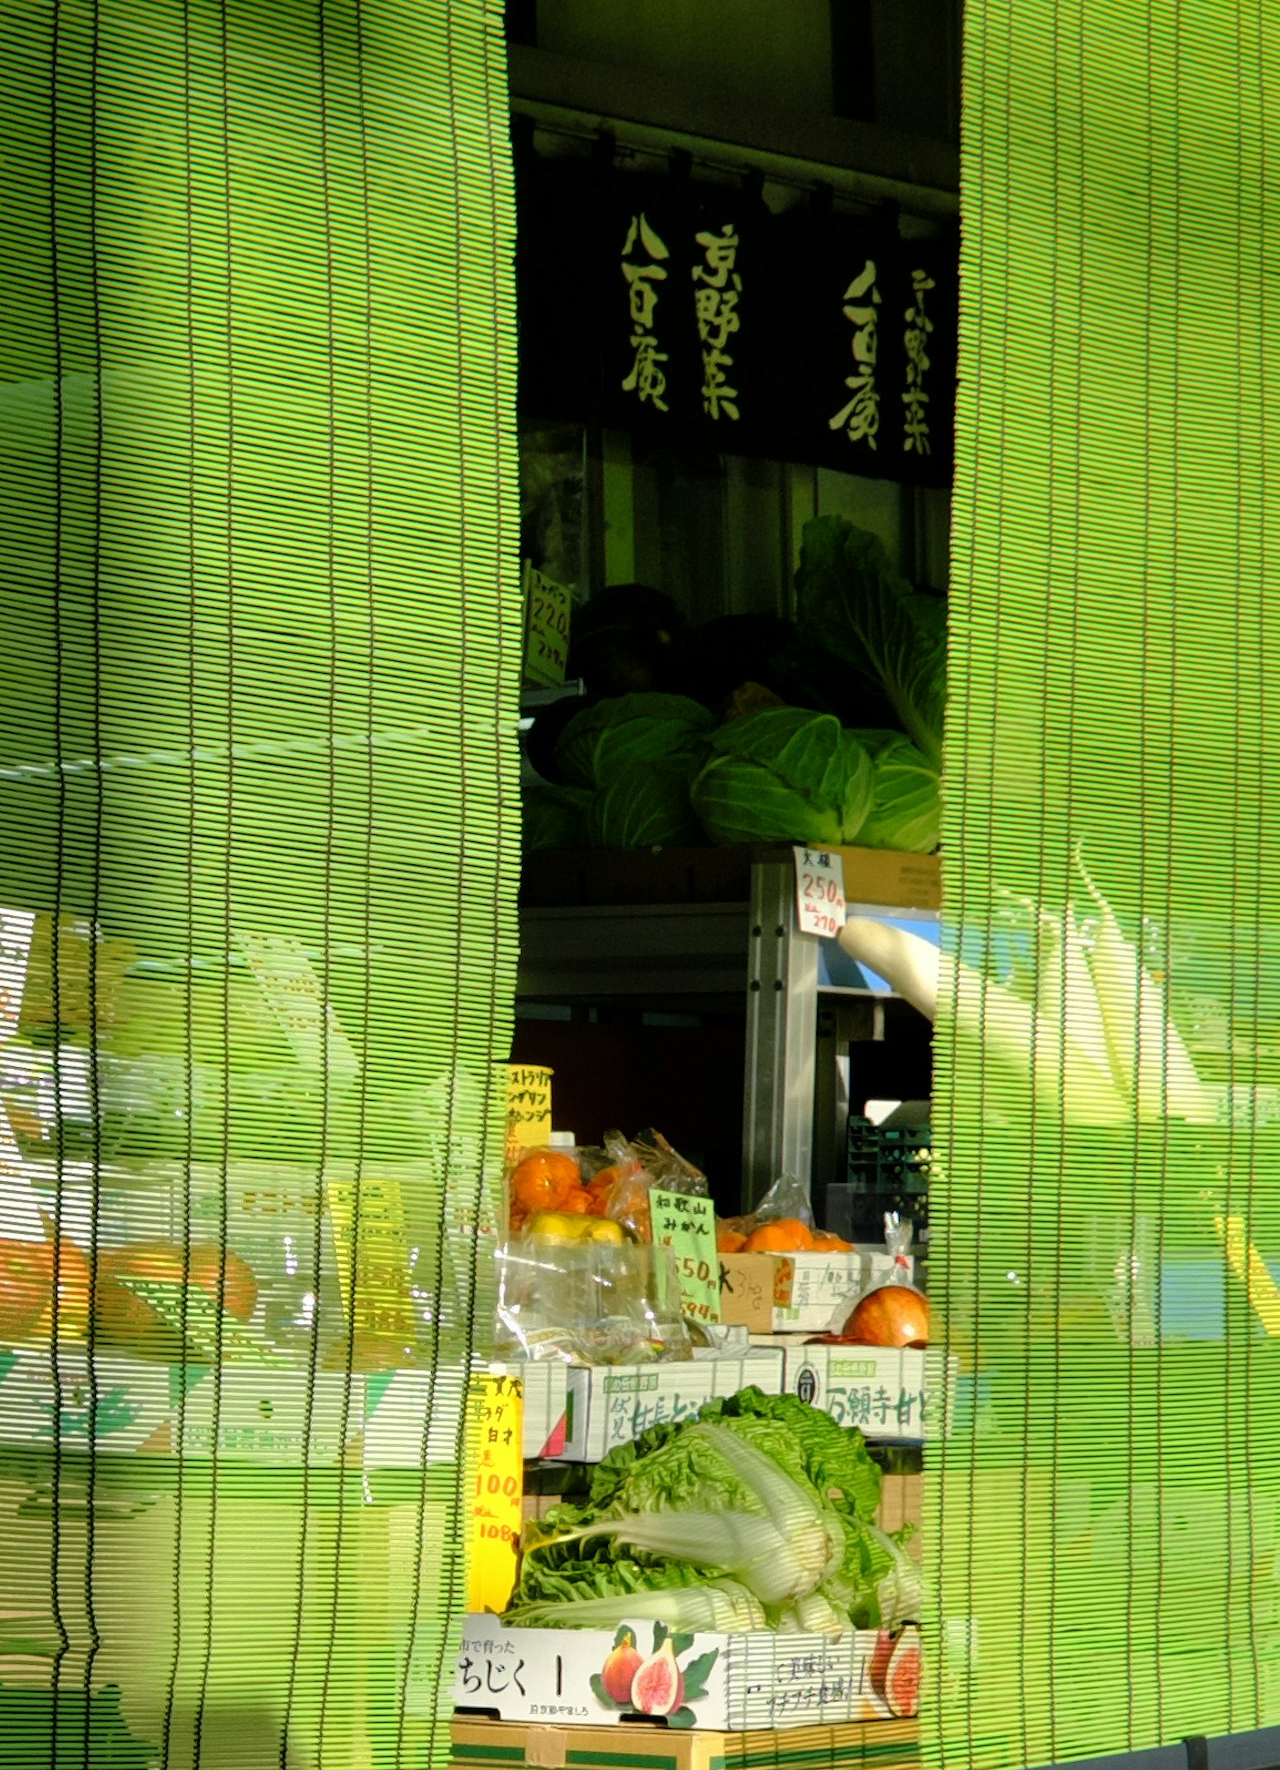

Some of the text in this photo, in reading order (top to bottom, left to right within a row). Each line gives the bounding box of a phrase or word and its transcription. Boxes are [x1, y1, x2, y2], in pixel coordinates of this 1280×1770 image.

[621, 212, 670, 413] 八百廣
[691, 222, 743, 422] 京野菜
[900, 268, 936, 456] 京野菜
[655, 1194, 707, 1215] 和歌山
[663, 1216, 710, 1236] みかん
[826, 1385, 924, 1426] 万願寺甘
[458, 1657, 527, 1697] ちじく
